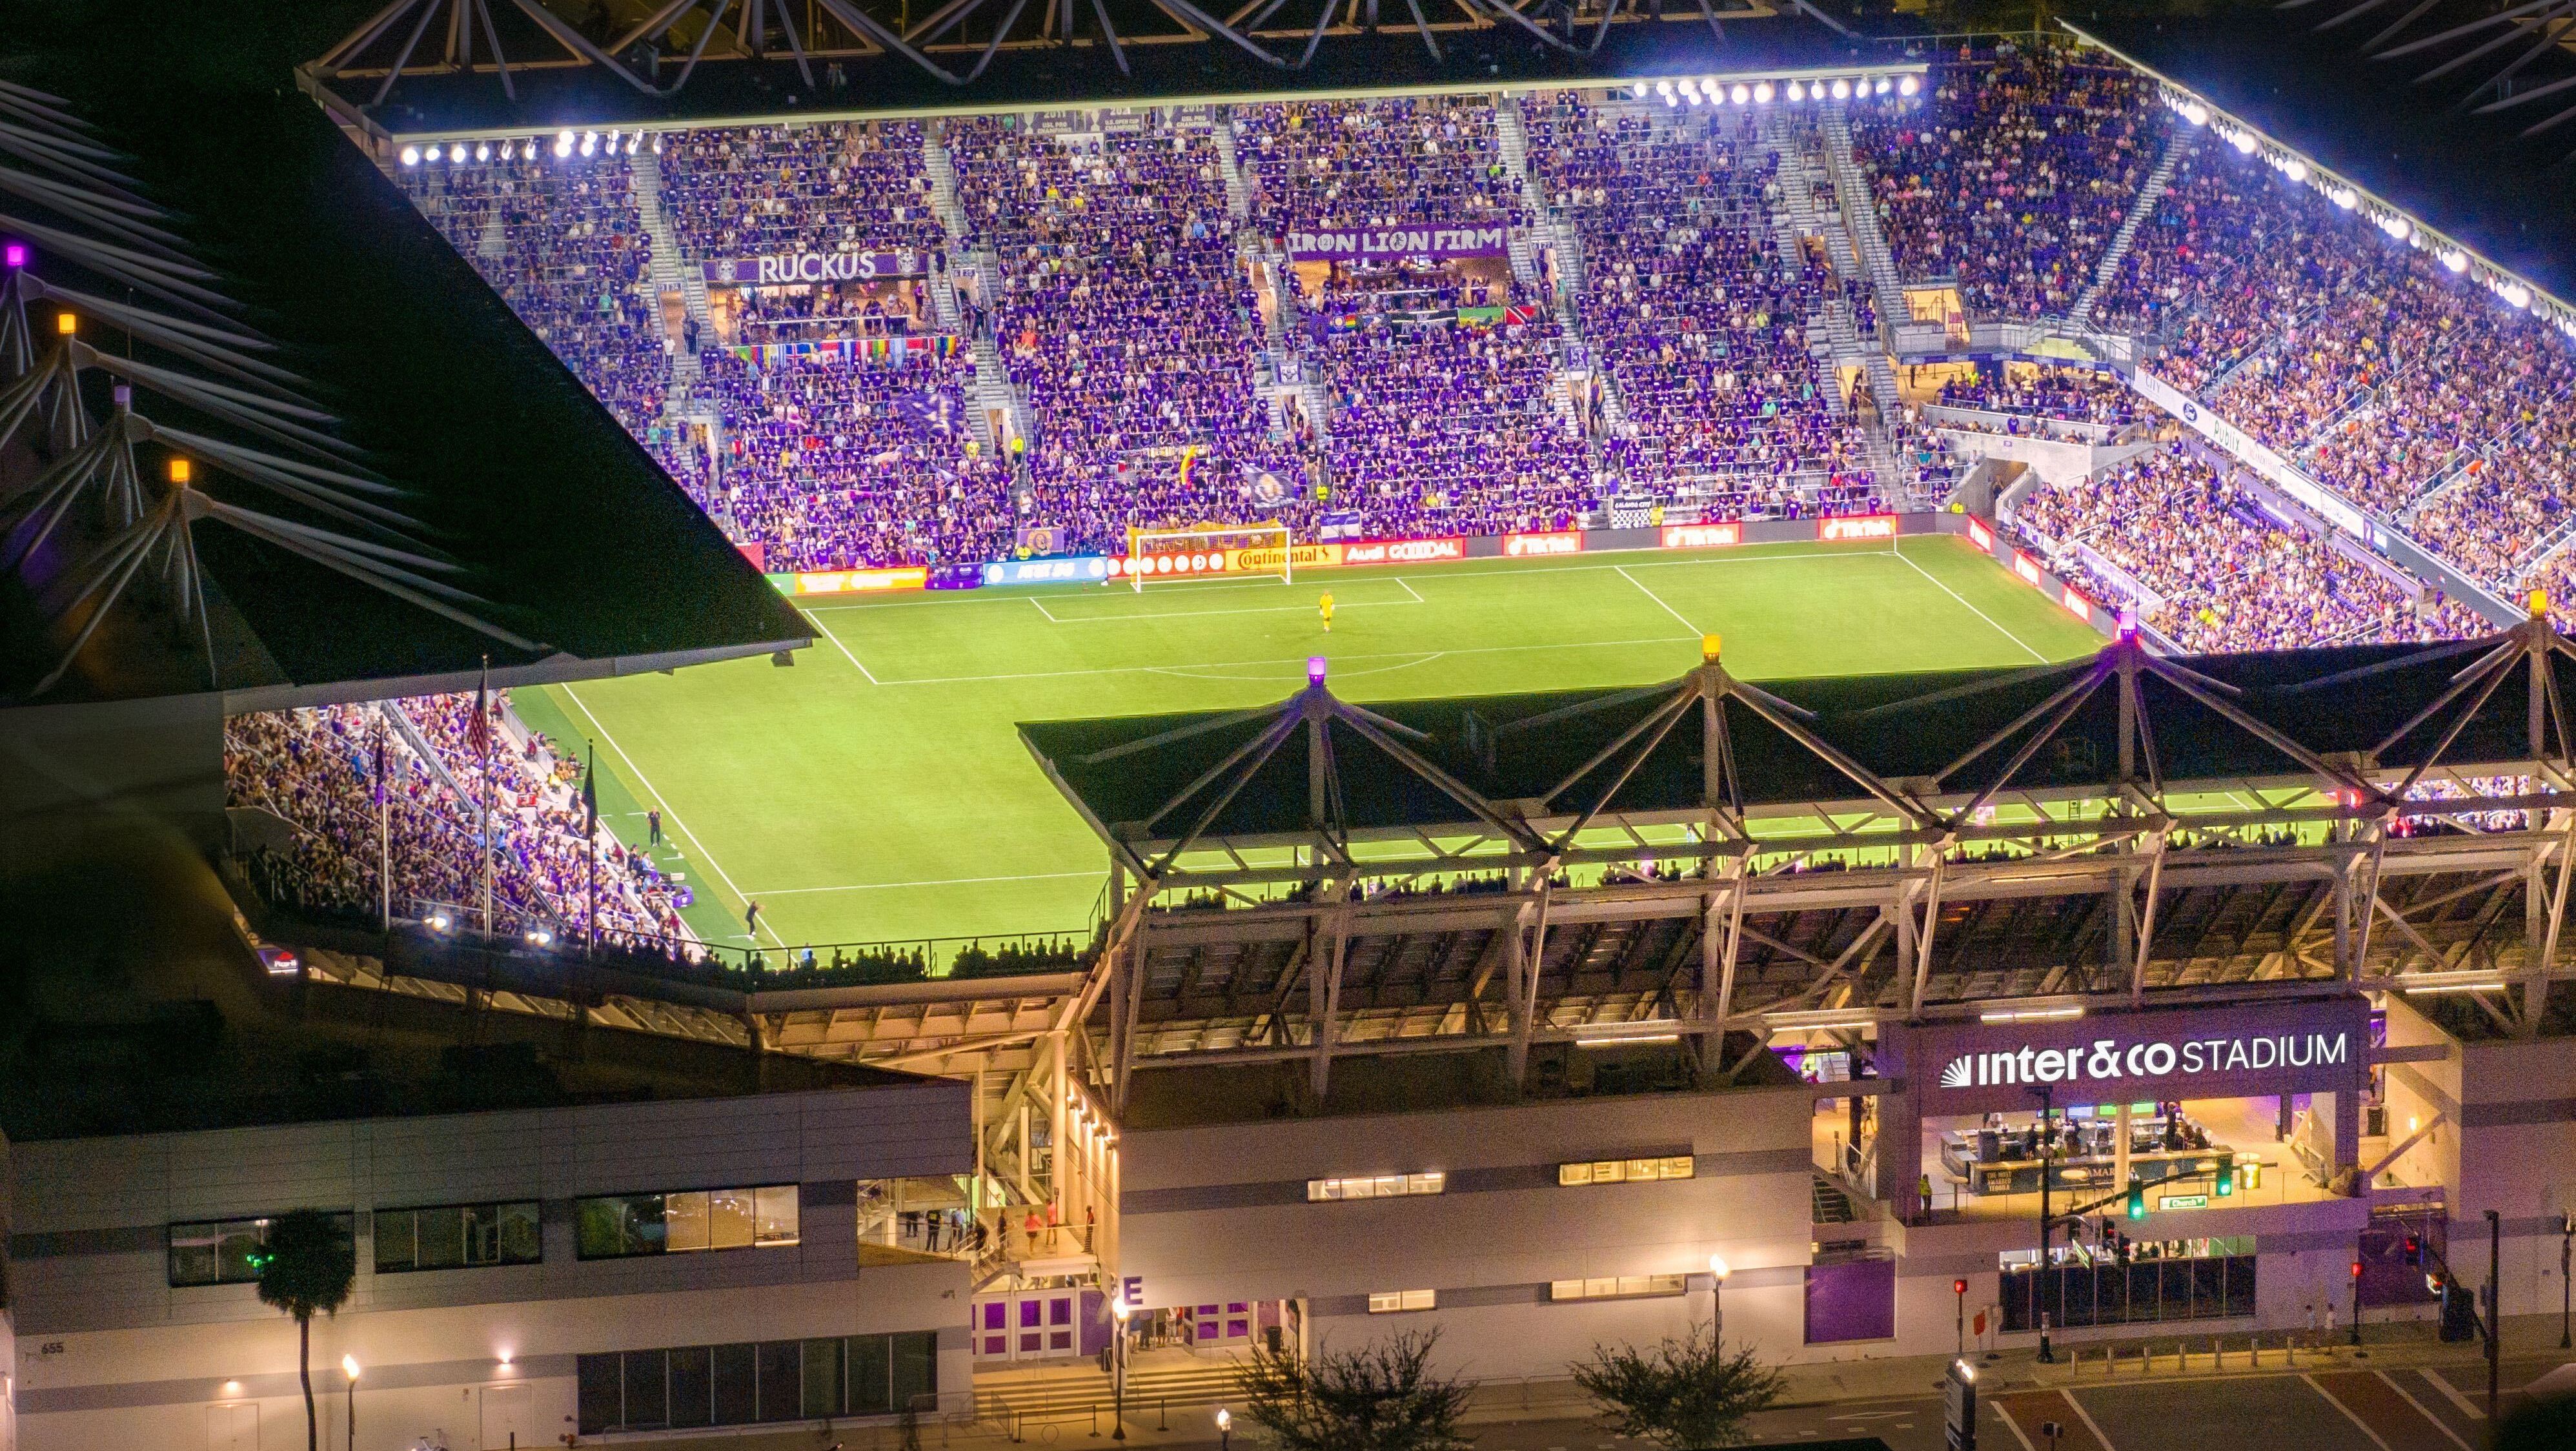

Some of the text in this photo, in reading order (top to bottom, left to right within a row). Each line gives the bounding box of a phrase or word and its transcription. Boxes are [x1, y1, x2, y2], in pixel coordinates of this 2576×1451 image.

[1289, 228, 1501, 253] IRON LION FIRM
[758, 250, 877, 284] RUCKUS
[2145, 374, 2162, 394] CITY
[2213, 420, 2240, 453] Publix
[1346, 546, 1385, 561] Audi
[2182, 1033, 2346, 1073] STADIUM
[1123, 1276, 1142, 1305] E
[41, 1343, 64, 1354] 655
